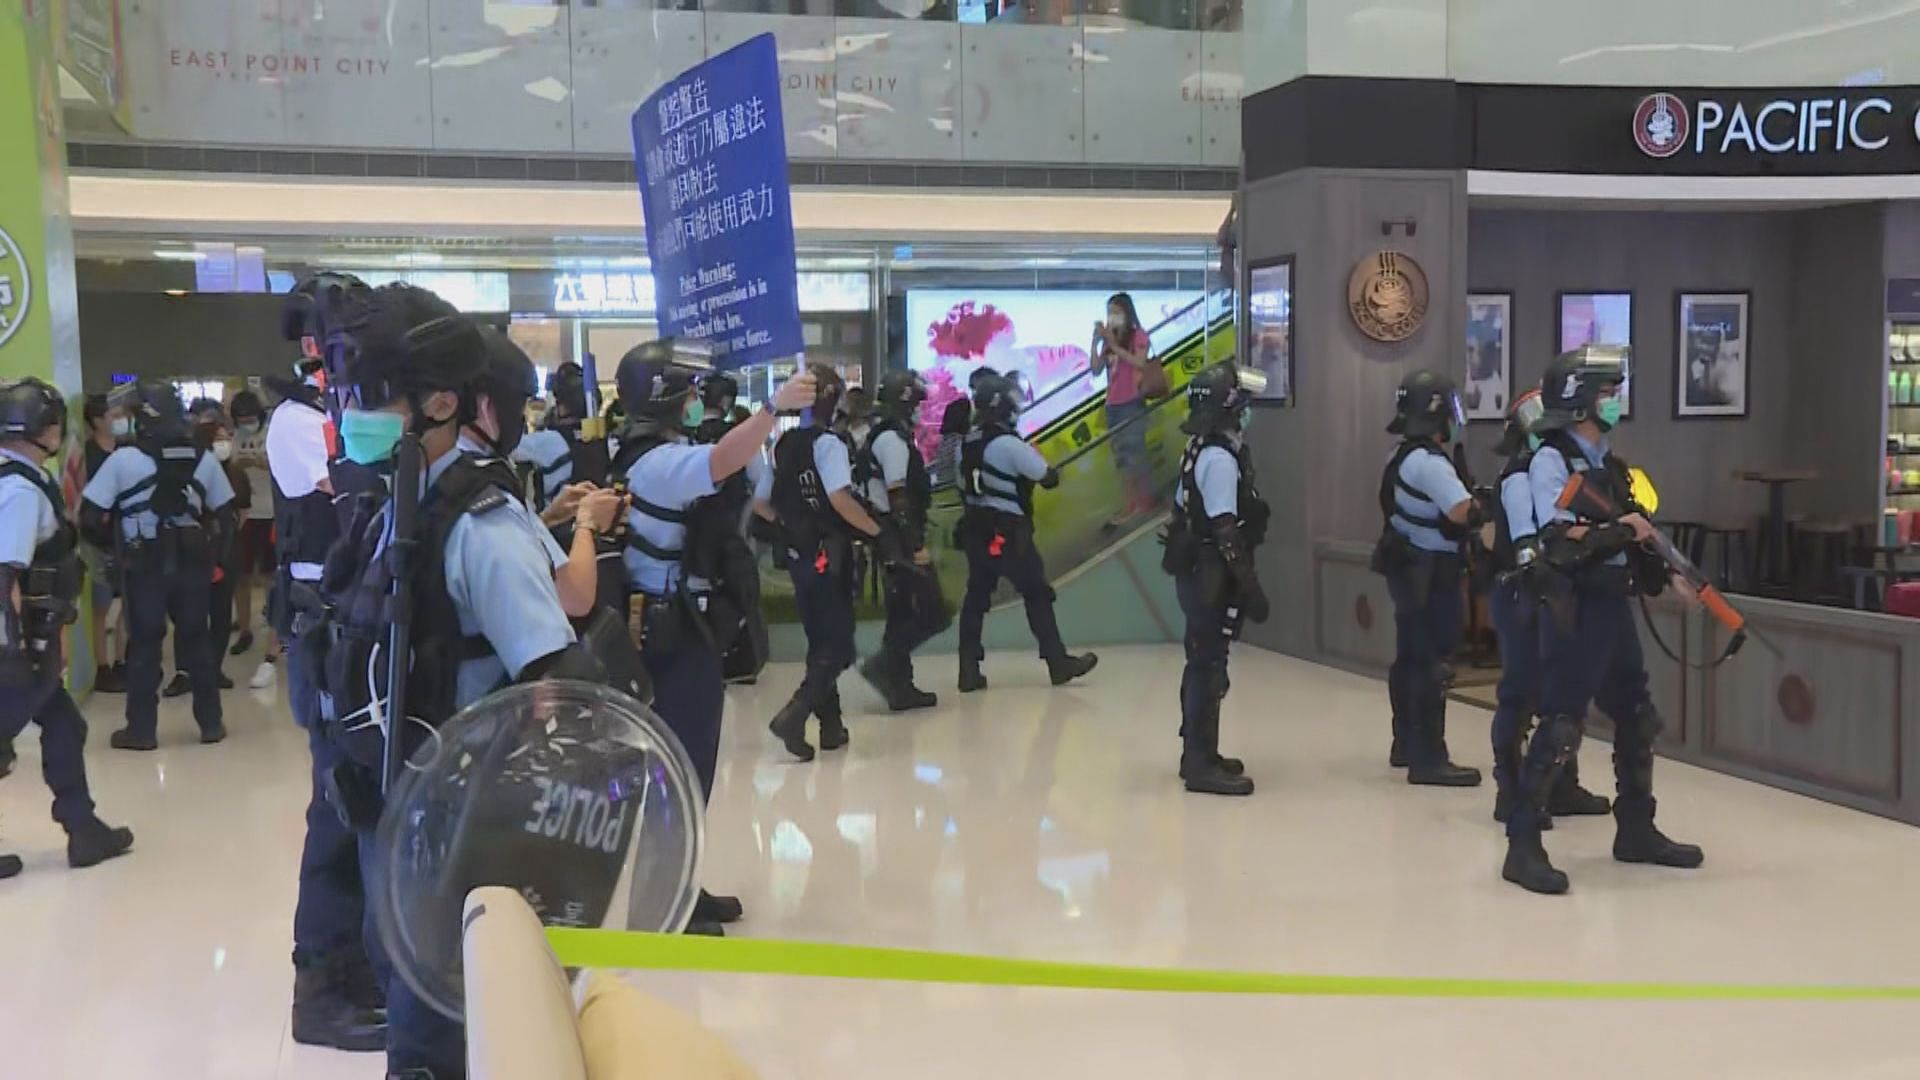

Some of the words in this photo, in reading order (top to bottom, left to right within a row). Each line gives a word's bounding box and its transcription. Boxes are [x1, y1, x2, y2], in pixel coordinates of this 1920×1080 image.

[170, 49, 229, 68] EAST
[246, 53, 321, 74] POINT
[336, 57, 391, 75] CITY
[785, 73, 837, 90] OINT
[851, 76, 897, 92] CITY
[1695, 97, 1893, 154] PACIFIC
[524, 776, 628, 853] POLICE
